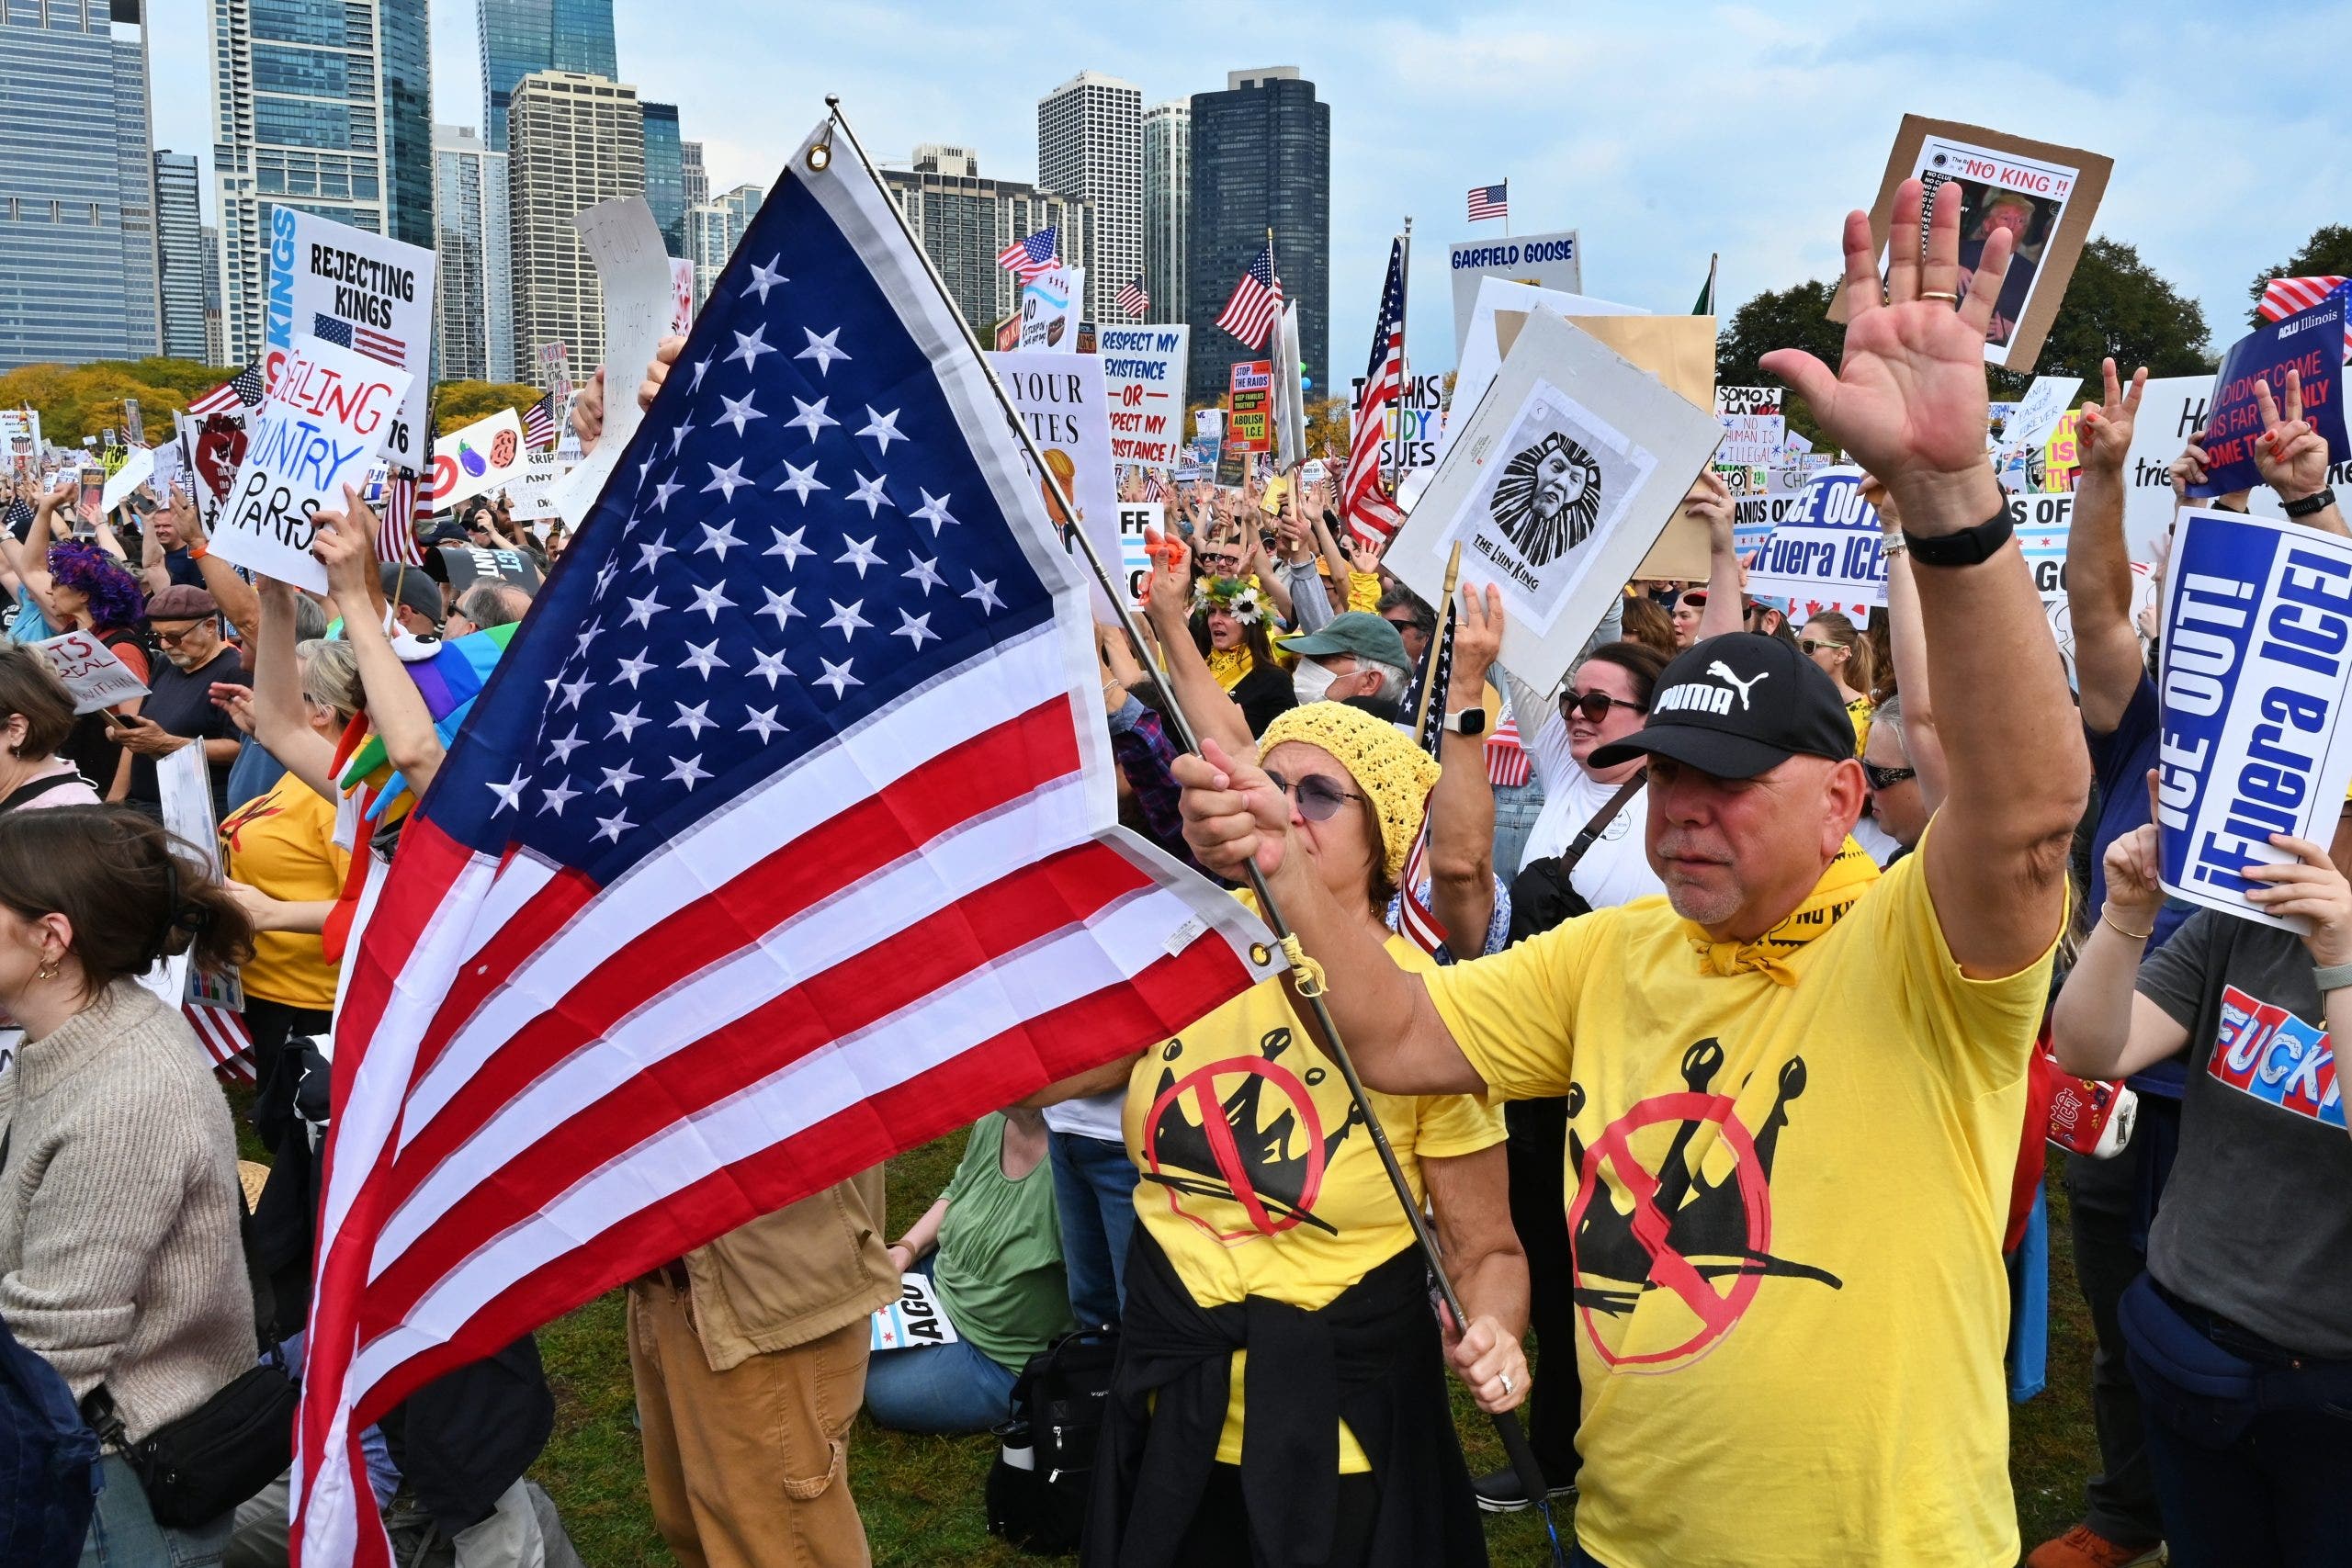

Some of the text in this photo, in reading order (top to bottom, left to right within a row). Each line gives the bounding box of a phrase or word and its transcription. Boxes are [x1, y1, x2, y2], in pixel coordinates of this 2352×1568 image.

[1965, 159, 1996, 179] NO
[1999, 169, 2050, 192] KING
[1452, 239, 1573, 269] GARFIELD GOOSE
[267, 208, 296, 349] KINGS
[311, 243, 413, 303] REJECTING
[334, 285, 392, 330] KINGS
[1023, 299, 1036, 322] NO
[2278, 310, 2338, 340] ACLU Illinois
[1102, 331, 1179, 353] RESPECT MY
[548, 369, 563, 383] KING
[1105, 358, 1167, 380] EXISTENCE
[1236, 367, 1250, 377] STOP
[2273, 350, 2322, 386] COME
[274, 349, 392, 435] SELLING
[1012, 372, 1083, 403] YOUR
[1123, 384, 1144, 407] OR
[1235, 376, 1268, 389] THE RAIDS
[1404, 375, 1441, 410] HAS
[1718, 386, 1776, 405] SOMOS
[2301, 378, 2330, 408] NLY
[1234, 413, 1263, 425] ABOLISH
[1727, 401, 1780, 416] LA VOZ
[1007, 412, 1079, 445] STES
[1110, 412, 1166, 434] PECT MY
[1246, 425, 1263, 437] I.C.E.
[1743, 418, 1758, 430] NO
[2058, 414, 2080, 434] TH
[2206, 417, 2227, 441] HIS
[2230, 403, 2258, 431] FAR
[1112, 437, 1167, 461] SISTANCE
[1725, 430, 1775, 444] HUMAN IS
[245, 417, 365, 491] OUNTRY
[1380, 441, 1436, 468] SUES
[1728, 446, 1772, 463] ILLEGAL
[2052, 441, 2075, 463] IS
[526, 473, 553, 484] ANY
[1782, 471, 1810, 489] CHI
[2047, 468, 2071, 489] TH
[2135, 457, 2172, 487] trie
[1735, 498, 1794, 525] ANDS OF
[1779, 483, 1821, 525] ICE
[2036, 498, 2072, 524] OF
[1120, 511, 1150, 535] FF
[496, 550, 524, 573] ECT
[1474, 534, 1540, 591] THE LYIN KING
[1653, 682, 1735, 716] PUMA
[2158, 572, 2256, 831] ICE OUT!
[2193, 684, 2330, 897] ¡Fuera
[2214, 1001, 2334, 1102] FUCK
[900, 1283, 944, 1340] AGO
